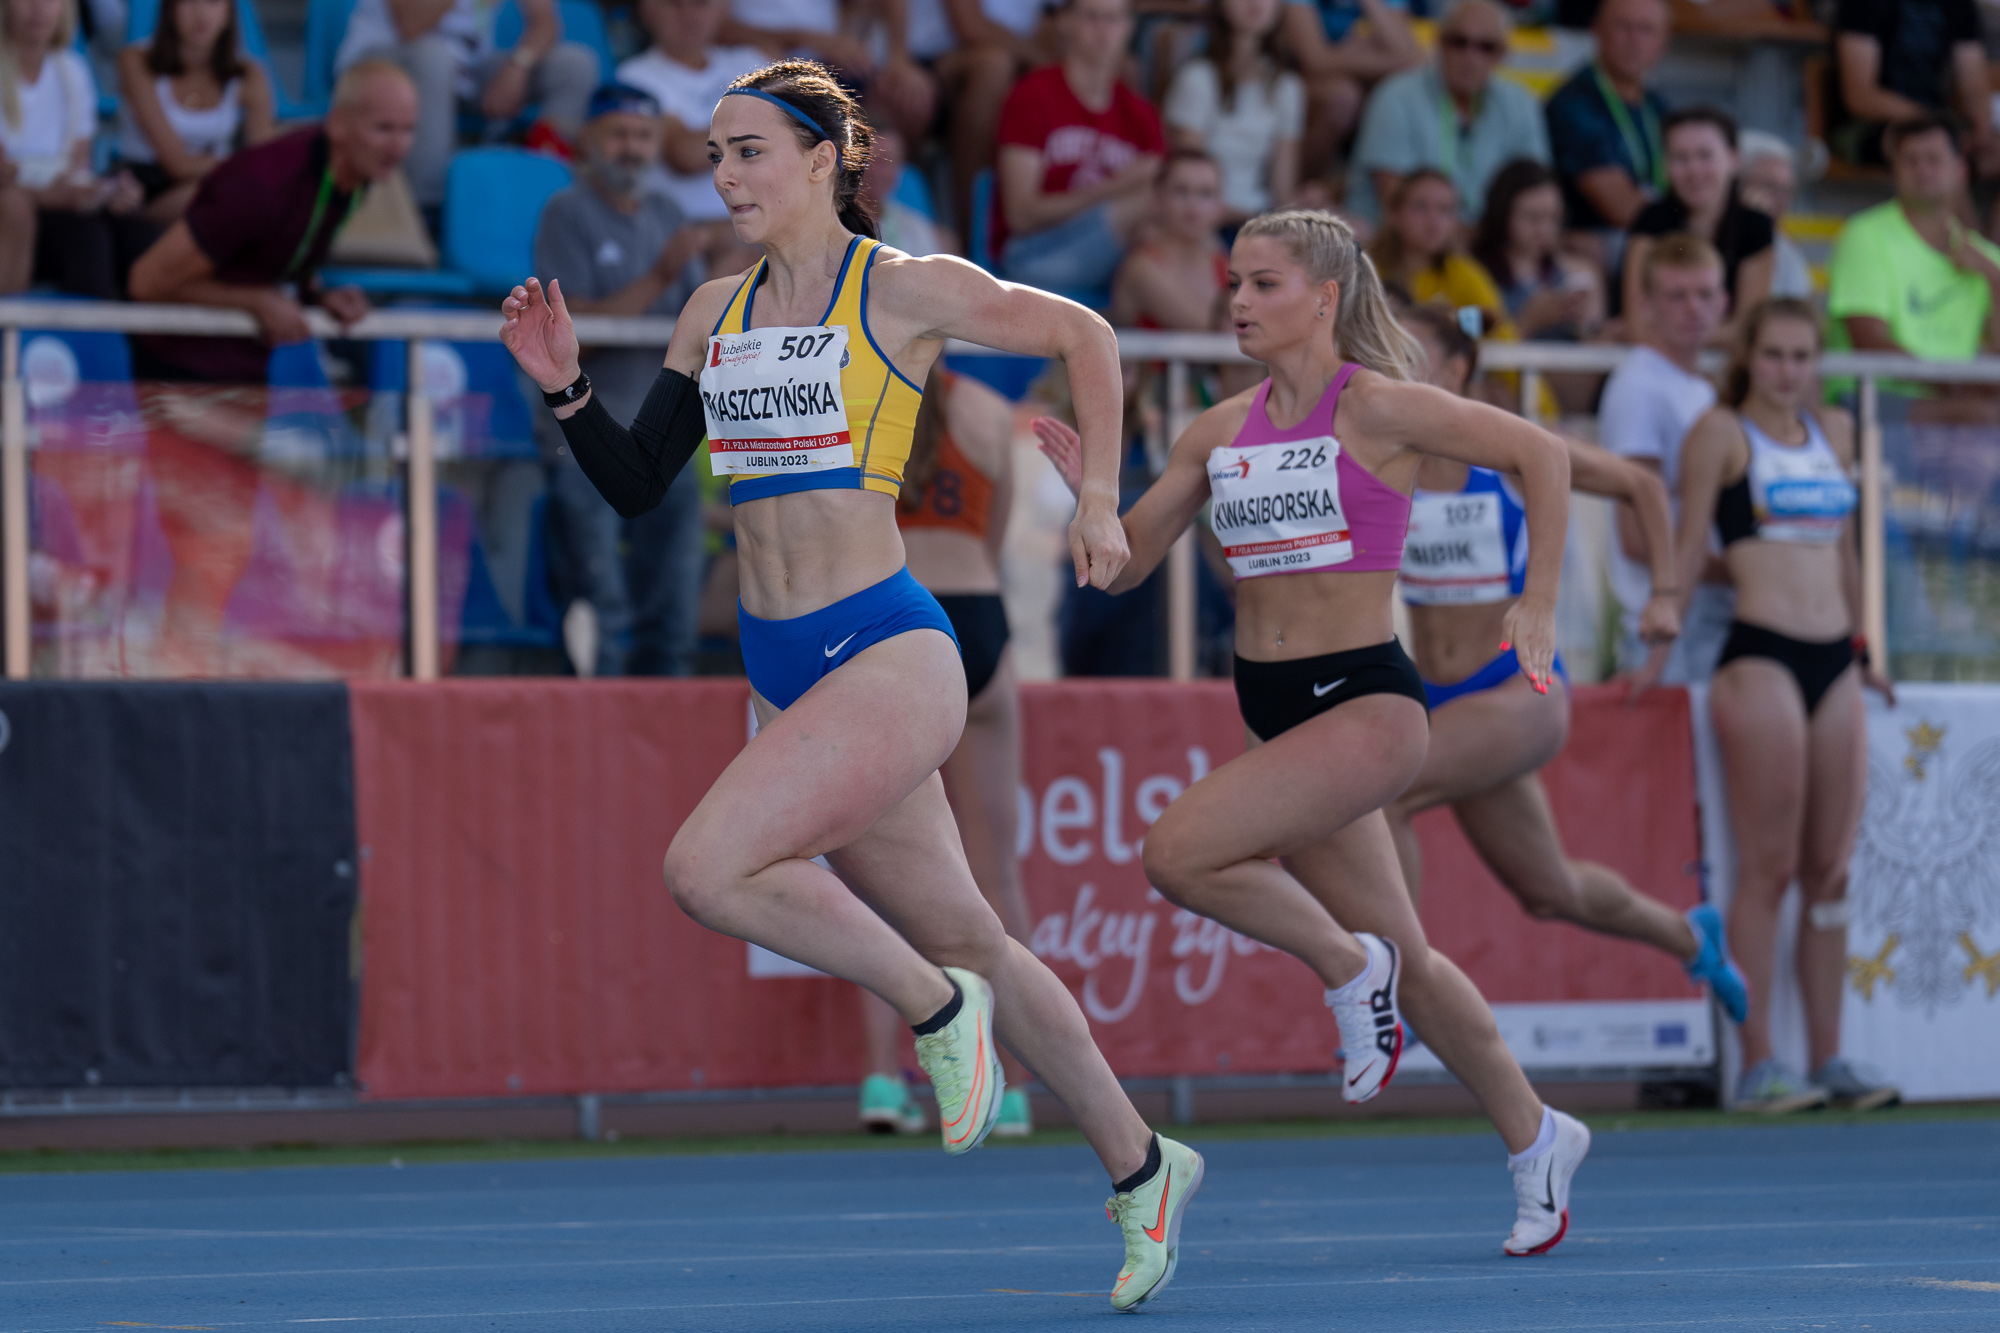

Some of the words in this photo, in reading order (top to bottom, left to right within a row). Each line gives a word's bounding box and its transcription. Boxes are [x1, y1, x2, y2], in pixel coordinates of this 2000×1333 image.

[721, 339, 761, 355] lubelskie
[778, 333, 835, 362] 507
[734, 440, 749, 450] PZLA
[750, 440, 791, 450] Mistrzostwa
[793, 438, 817, 449] Polski
[819, 435, 839, 447] U20
[746, 456, 779, 467] LUBLIN
[780, 454, 808, 467] 2023
[1276, 445, 1327, 471] 226
[1214, 488, 1338, 532] KWASIBORSKA
[1444, 502, 1486, 527] 107
[1252, 542, 1292, 553] Mistrzostwa
[1294, 536, 1320, 547] Polski
[1321, 533, 1339, 543] U20
[1248, 557, 1280, 569] LUBLIN
[1282, 552, 1310, 565] 2023
[1371, 989, 1395, 1058] AIR
